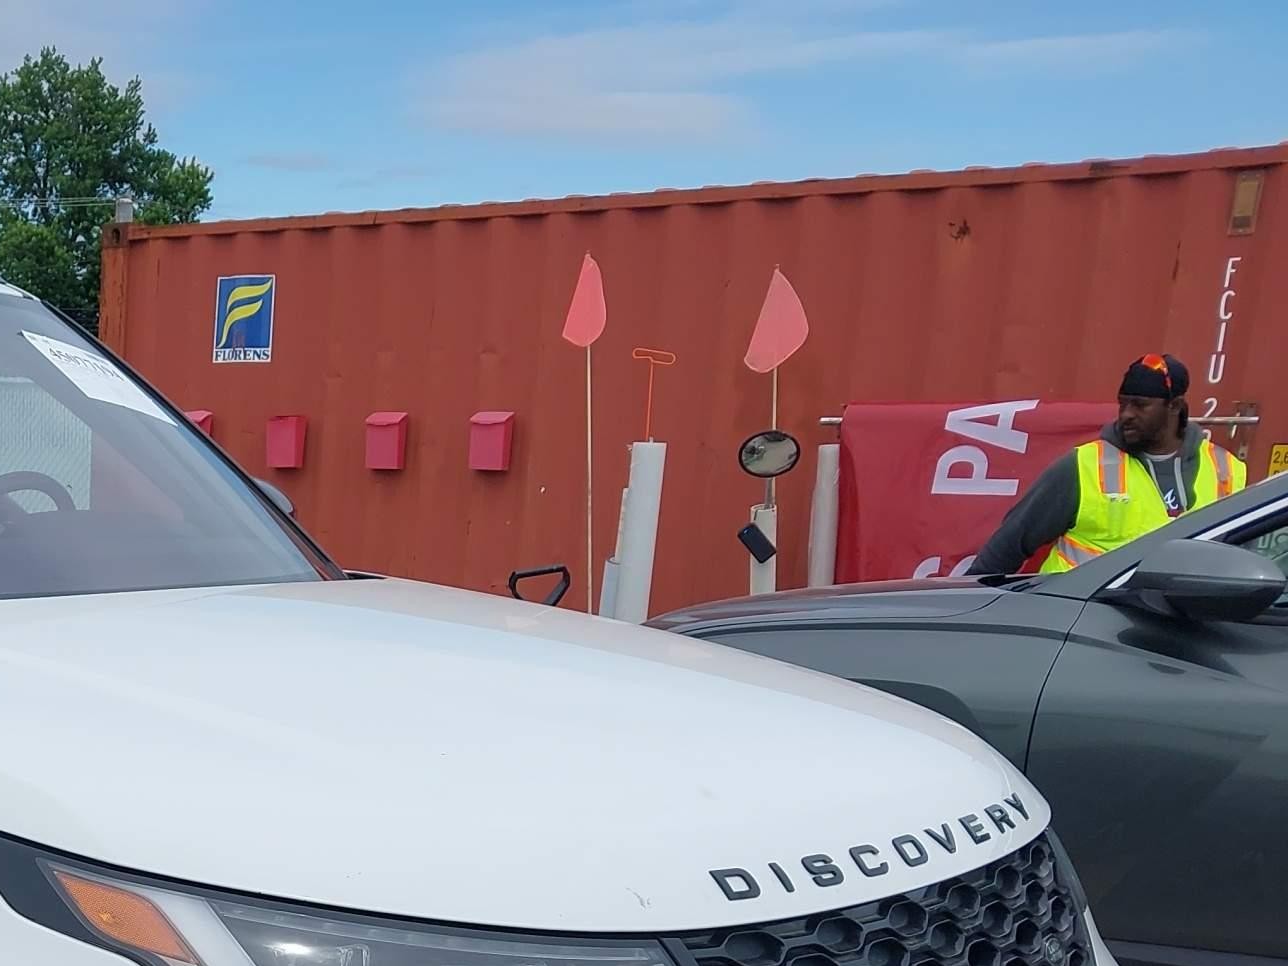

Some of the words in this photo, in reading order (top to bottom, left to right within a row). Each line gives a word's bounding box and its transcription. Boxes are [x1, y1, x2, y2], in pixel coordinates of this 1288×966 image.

[214, 349, 270, 362] FLORENS
[1208, 256, 1243, 384] FCIU
[708, 792, 1031, 902] DISCOVERY
